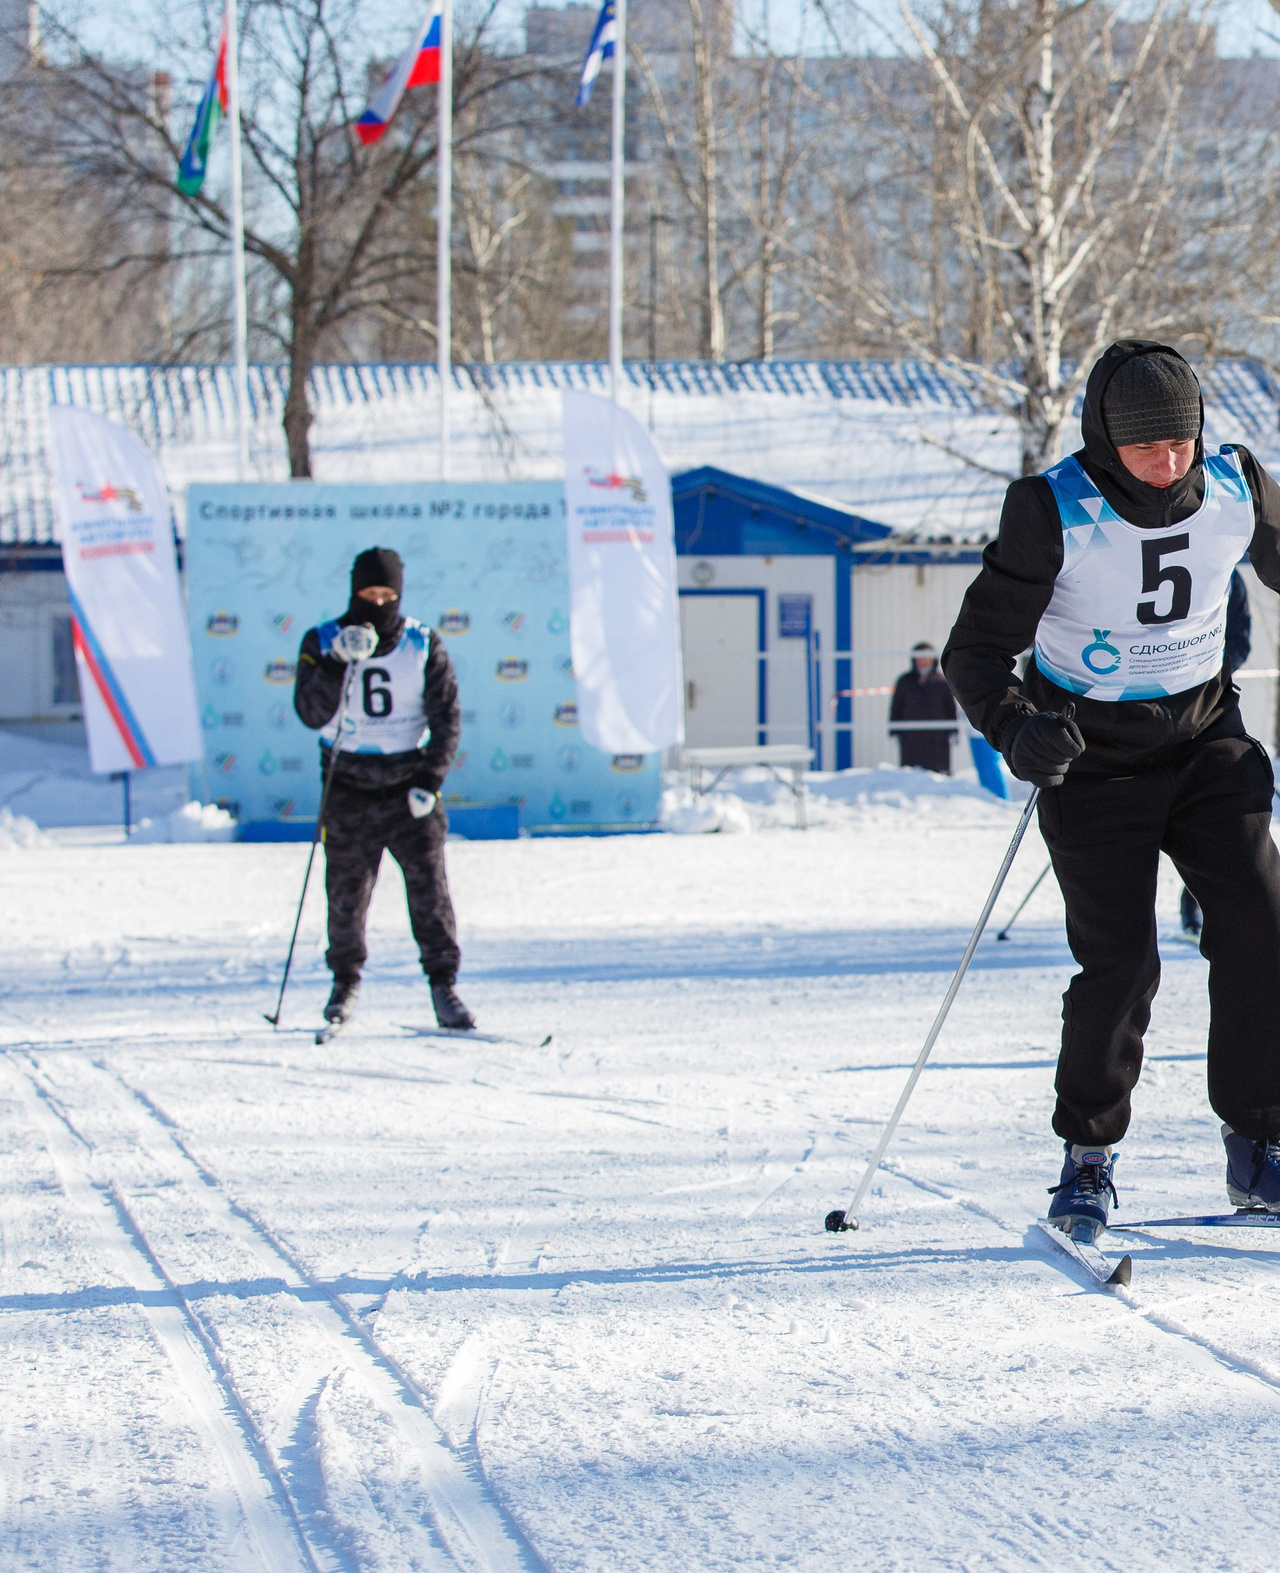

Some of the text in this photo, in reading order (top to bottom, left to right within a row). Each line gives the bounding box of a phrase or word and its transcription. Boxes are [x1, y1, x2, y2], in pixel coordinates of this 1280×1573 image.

[200, 501, 336, 522] Спортивная
[350, 503, 421, 519] школа
[430, 499, 465, 519] №2
[473, 503, 551, 521] города
[1137, 533, 1192, 625] 5
[1129, 634, 1207, 656] СДЮСШОР
[362, 667, 392, 718] 6
